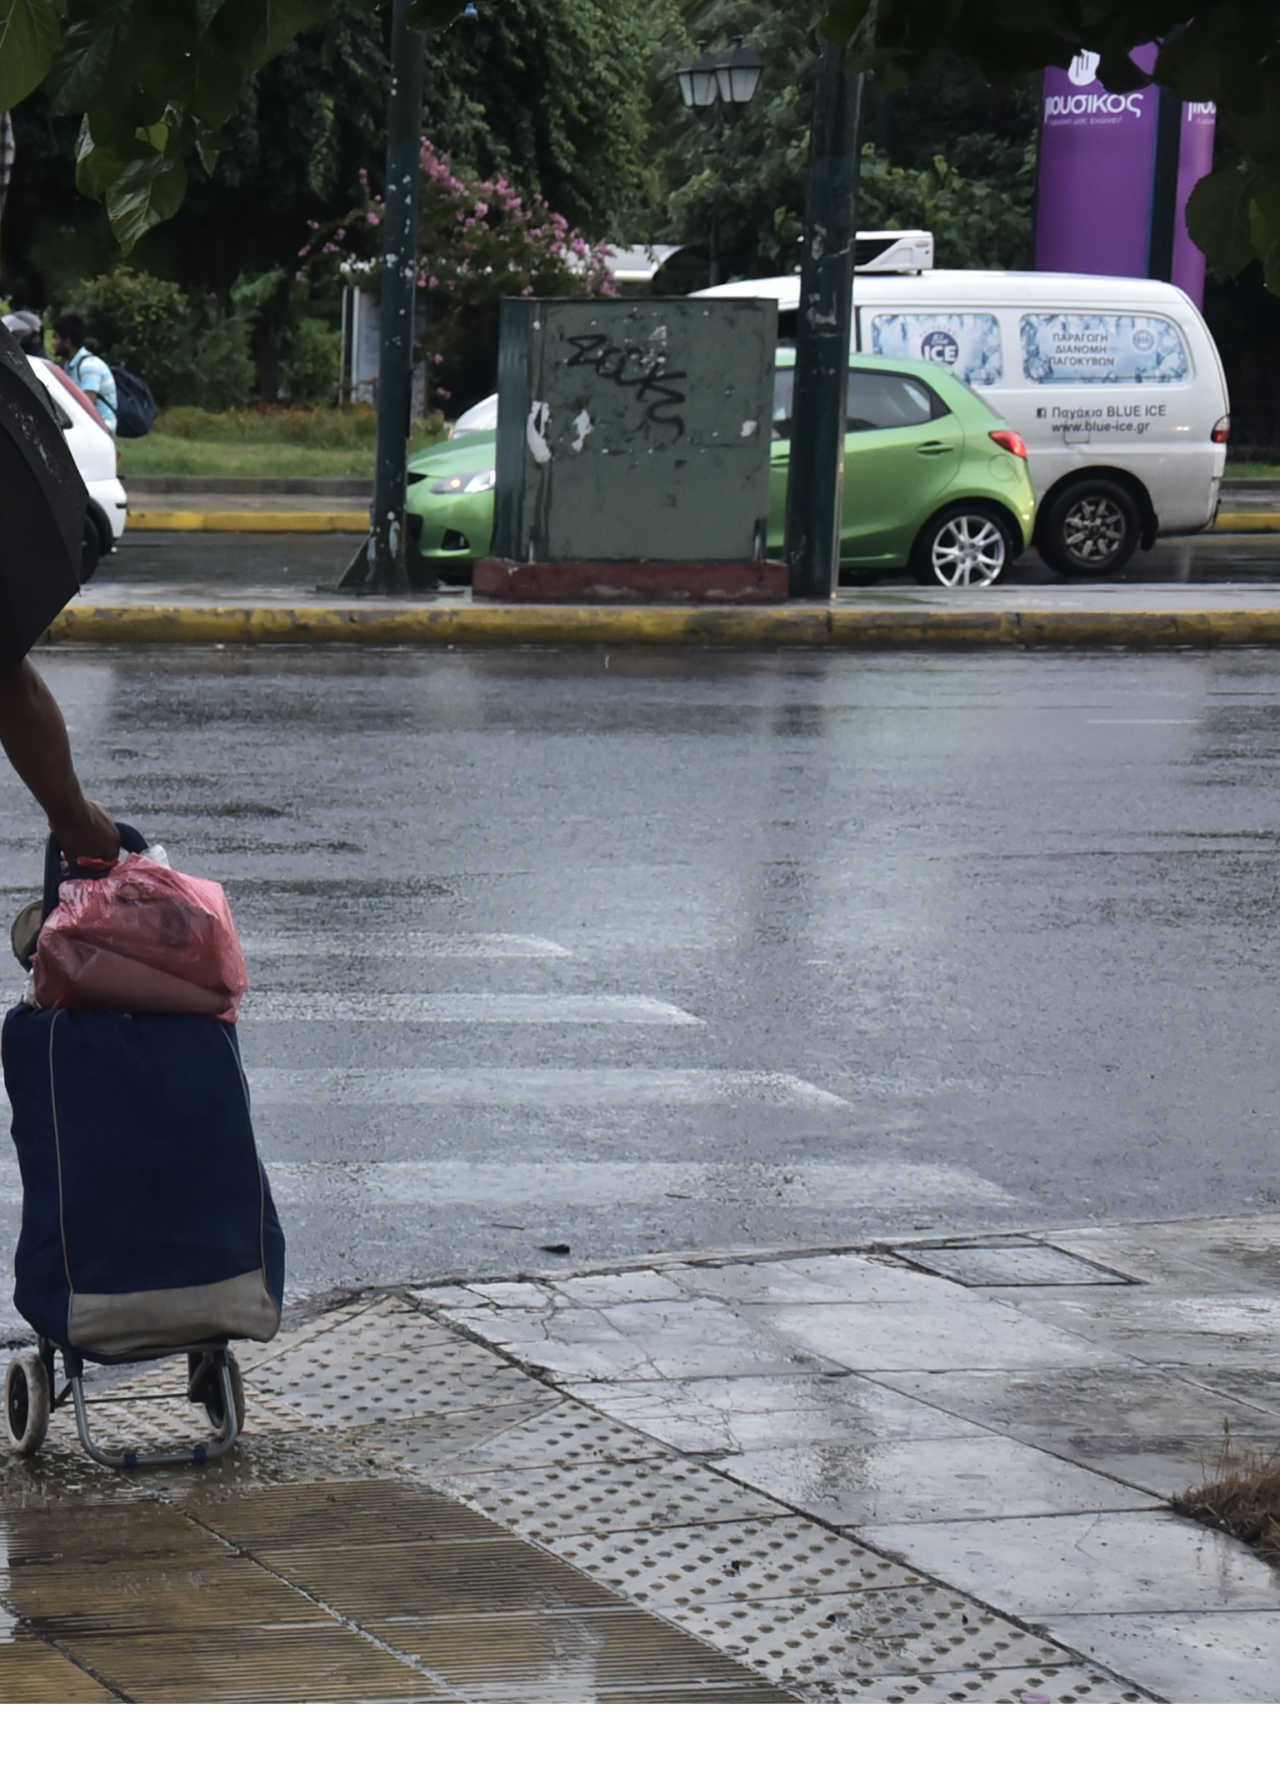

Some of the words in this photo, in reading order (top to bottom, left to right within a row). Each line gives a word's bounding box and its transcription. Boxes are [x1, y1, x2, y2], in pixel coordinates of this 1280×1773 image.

[1052, 333, 1109, 342] ΠΑΡΑΓΩΓΗ
[923, 345, 957, 361] ICE
[1055, 345, 1107, 354] ΔΙΑΝΟΜΗ
[1049, 356, 1115, 366] ΠΑΓΟΚΥΒΩΝ
[1052, 406, 1102, 419] Παγάκια
[1107, 405, 1141, 417] BLUE
[1145, 404, 1167, 416] ICE
[1052, 421, 1150, 434] www.blue-ice.gr
